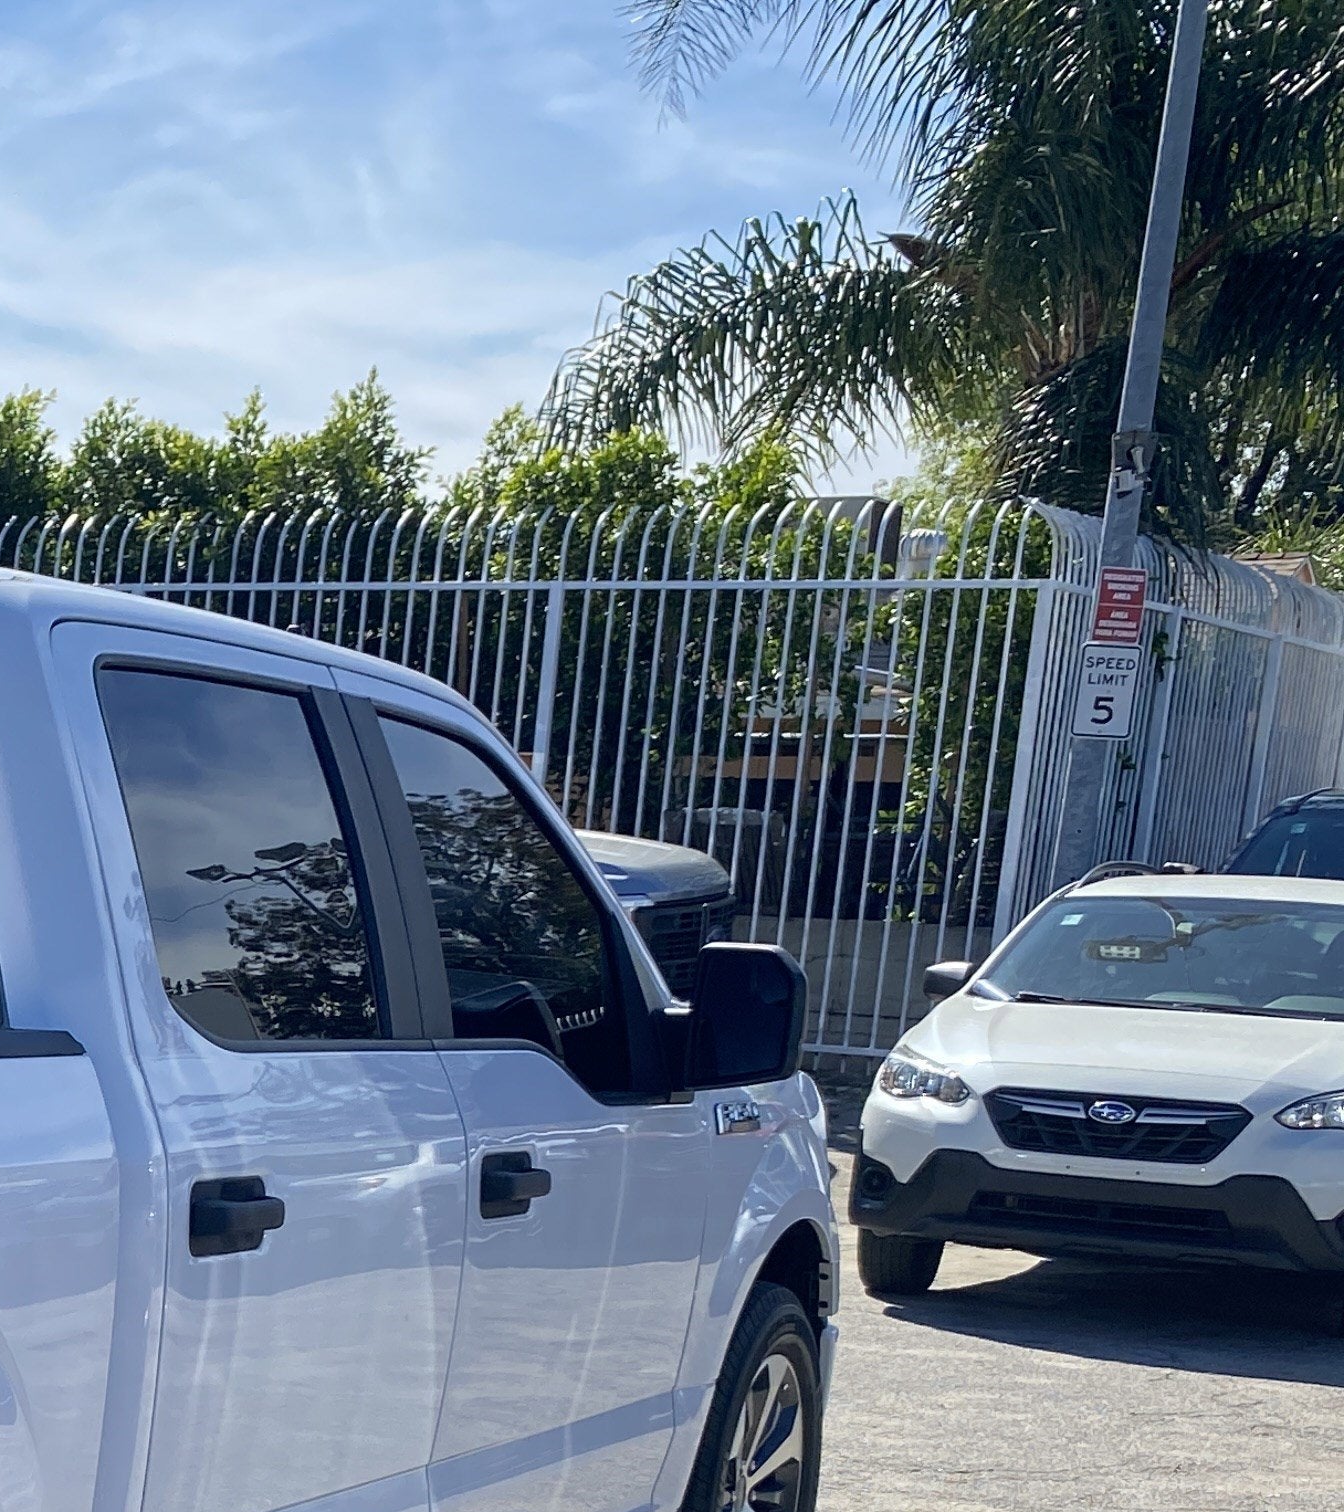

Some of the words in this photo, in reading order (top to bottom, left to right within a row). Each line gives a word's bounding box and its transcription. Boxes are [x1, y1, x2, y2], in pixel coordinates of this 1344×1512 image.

[1085, 656, 1135, 670] SPEED
[1087, 673, 1129, 686] LIMIT
[1090, 696, 1114, 725] 5
